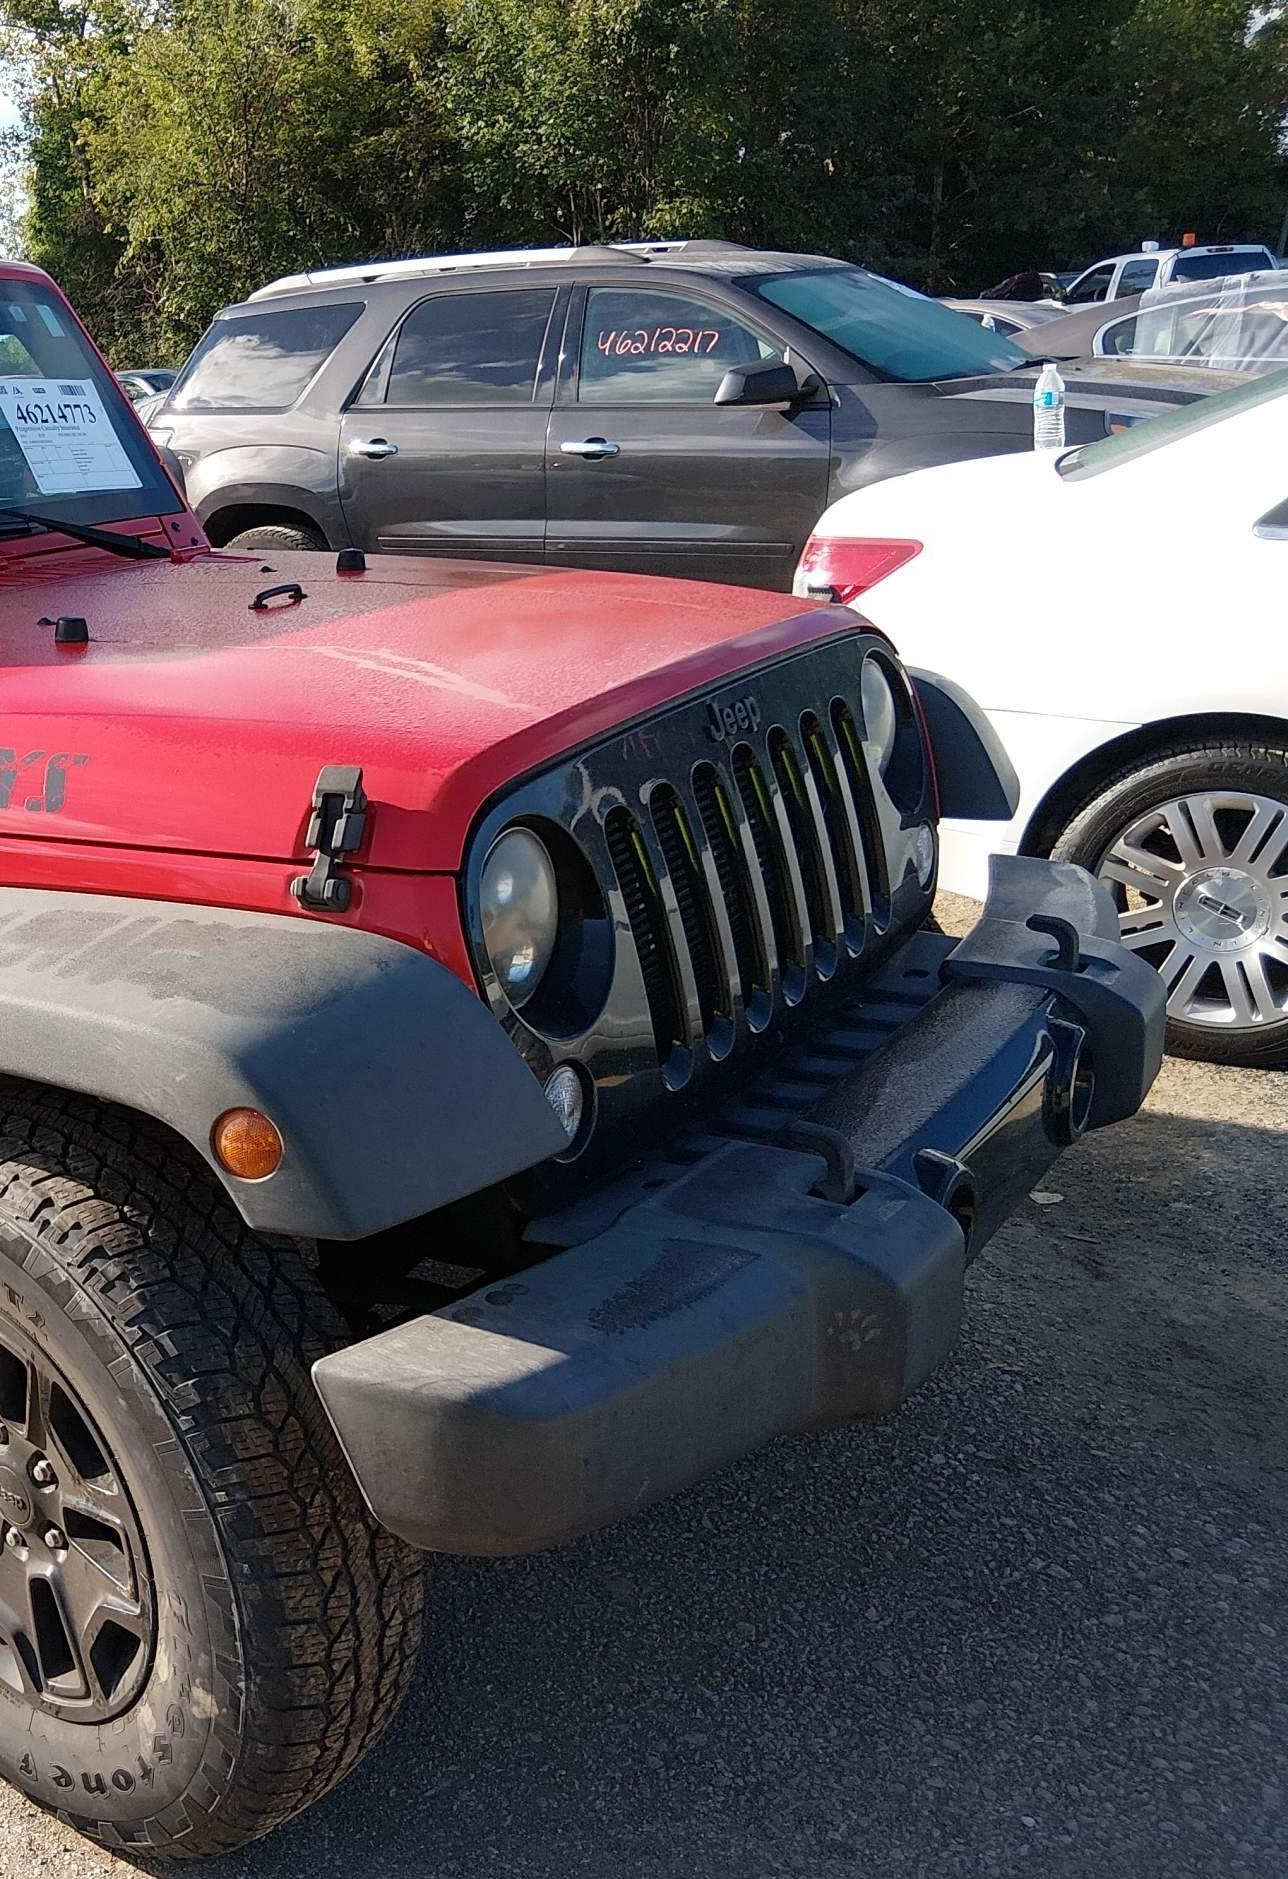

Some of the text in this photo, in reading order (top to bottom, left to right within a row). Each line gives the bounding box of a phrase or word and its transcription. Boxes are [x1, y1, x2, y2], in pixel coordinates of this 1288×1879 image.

[598, 328, 719, 356] 46212217
[16, 403, 97, 424] 46214773
[710, 696, 761, 741] Jeep
